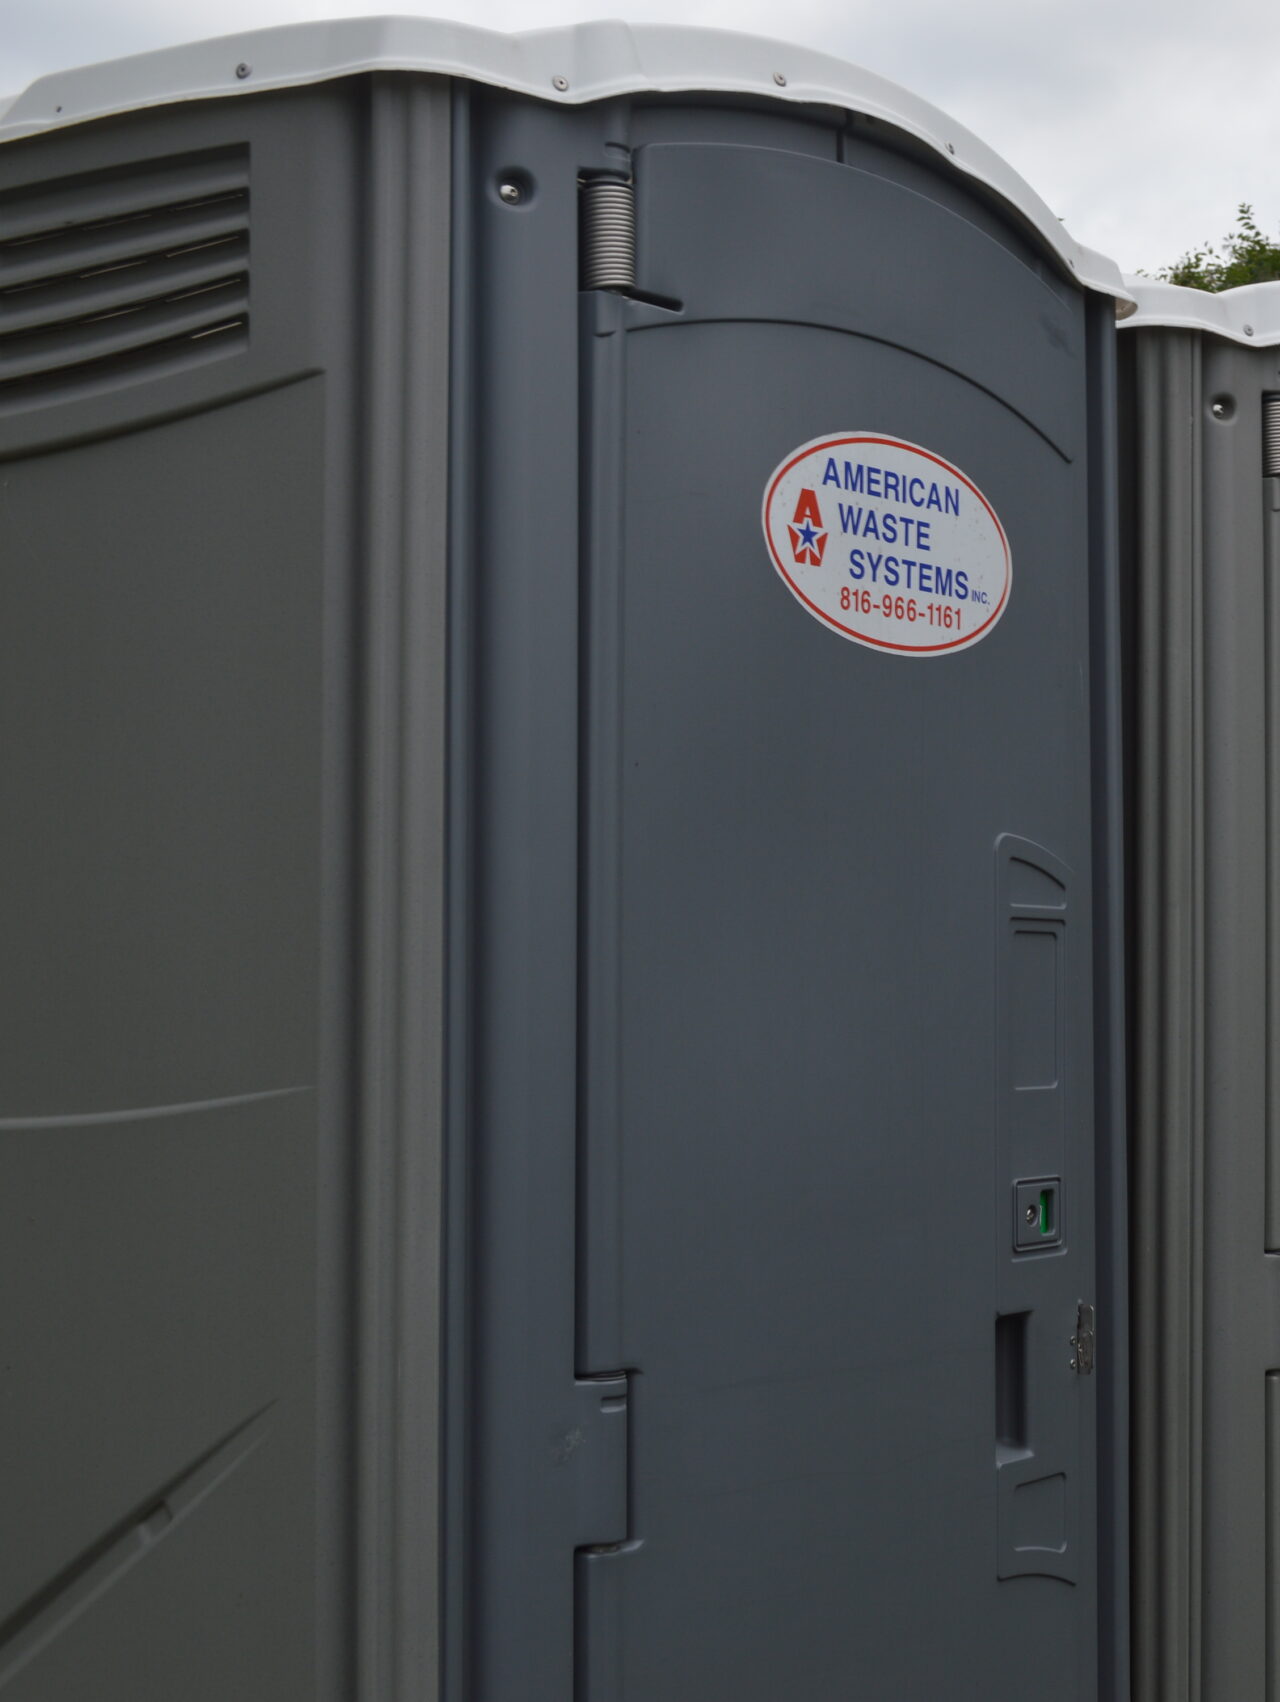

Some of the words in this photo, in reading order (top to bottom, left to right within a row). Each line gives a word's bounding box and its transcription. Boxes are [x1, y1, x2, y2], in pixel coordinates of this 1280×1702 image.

[822, 457, 960, 516] AMERICAN
[838, 503, 931, 551] WASTE
[849, 549, 968, 601] SYSTEMS
[971, 590, 990, 605] INC.
[840, 587, 961, 630] 816-966-1161
